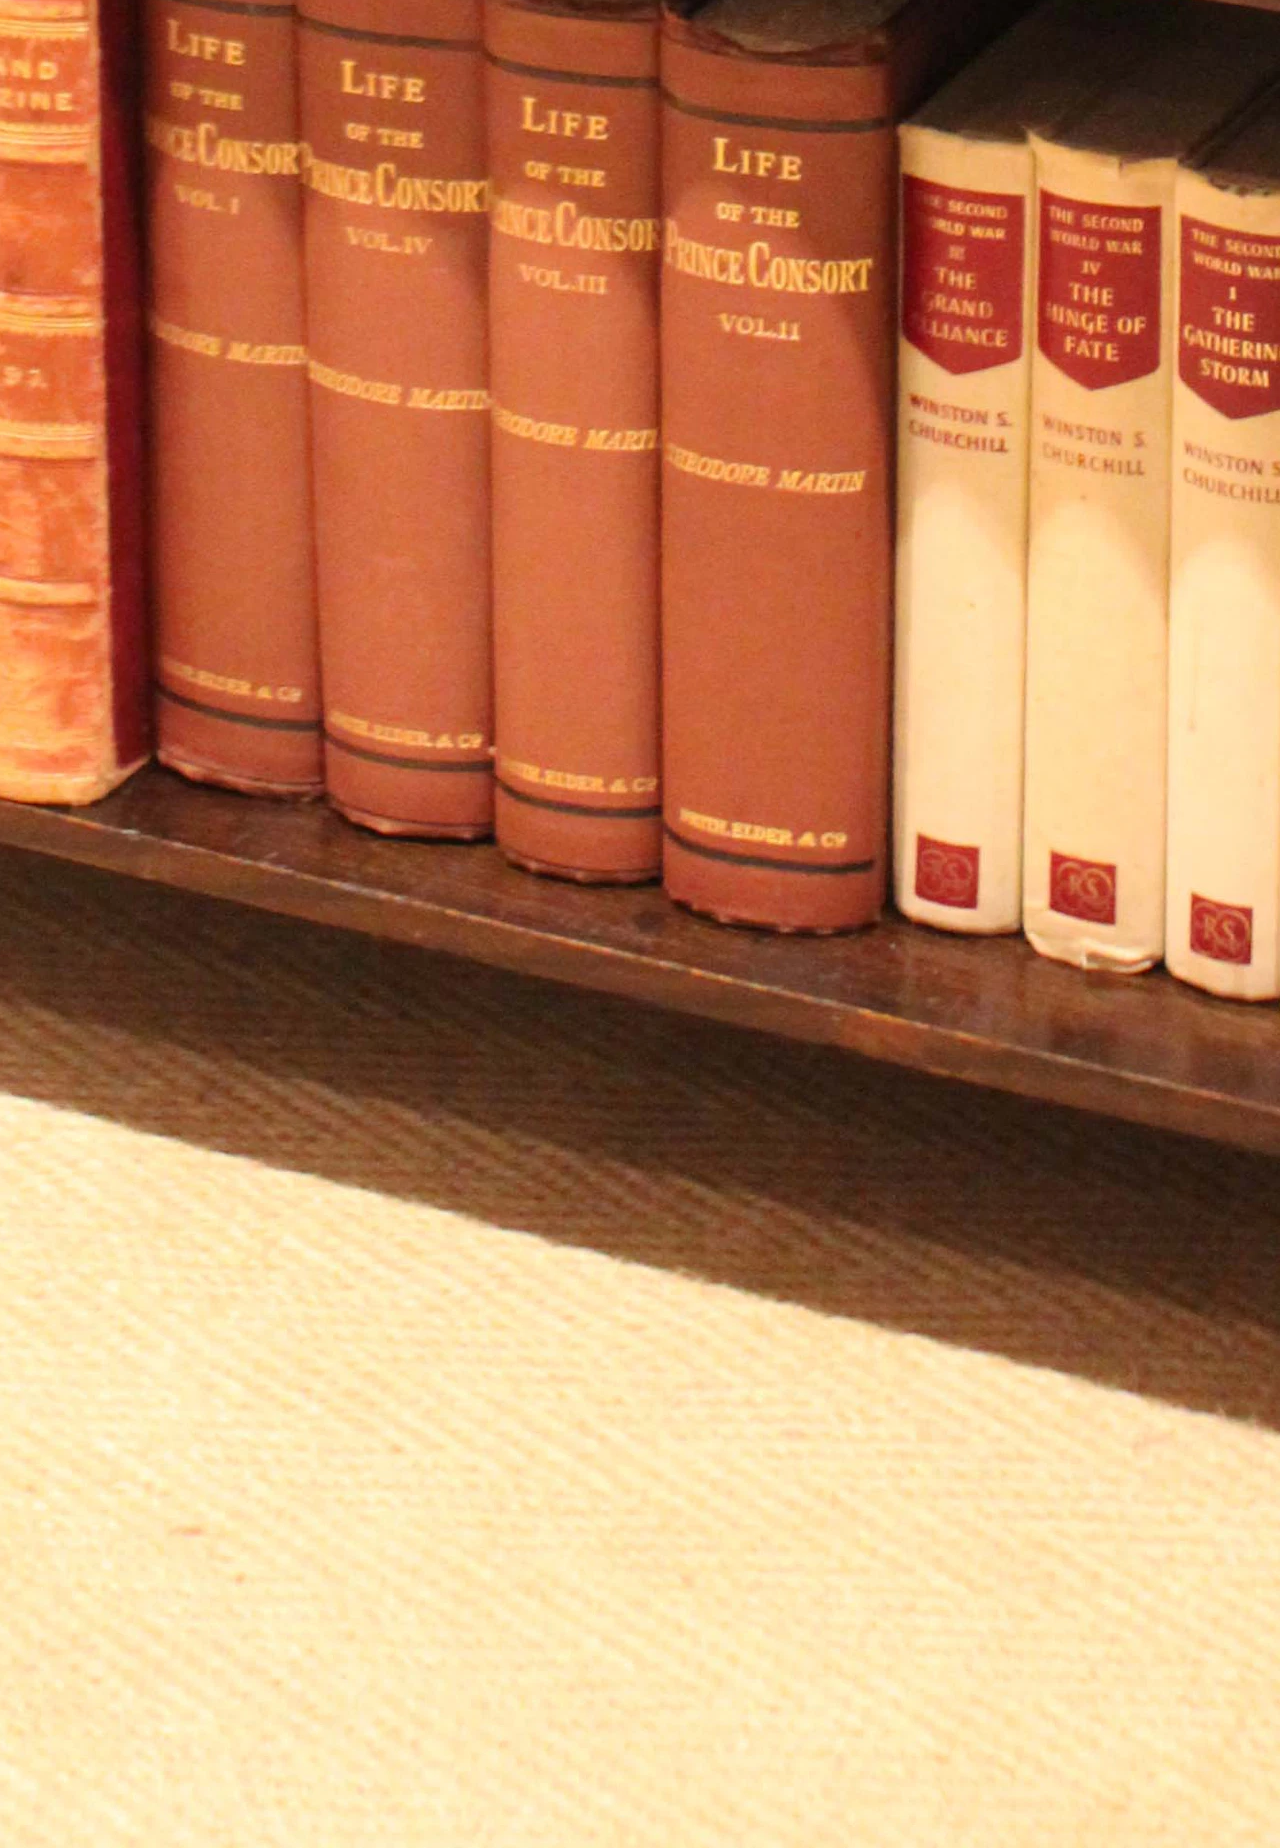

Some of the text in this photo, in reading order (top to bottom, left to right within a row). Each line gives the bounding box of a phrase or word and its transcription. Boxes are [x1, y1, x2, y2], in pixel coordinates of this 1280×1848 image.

[345, 122, 425, 151] OF THE
[524, 160, 606, 188] OF THE
[715, 201, 801, 229] OF THE
[1049, 205, 1146, 234] THE SECOND
[1105, 239, 1145, 257] WAR
[1191, 227, 1219, 250] THE
[1081, 259, 1102, 277] IV
[1192, 250, 1242, 277] WORLD
[933, 266, 977, 291] THE
[1069, 281, 1115, 309] THE
[1116, 315, 1148, 336] OF
[1211, 306, 1256, 334] THE
[1065, 336, 1120, 364] FATE
[1199, 358, 1271, 389] STORM
[909, 392, 989, 426] WINSTON
[908, 419, 1010, 454] CHURCHILL
[1042, 412, 1123, 447] WINSTON
[1042, 441, 1146, 477] CHURCHILL
[1183, 438, 1264, 476] WINSTON
[776, 469, 867, 494] MARTIN
